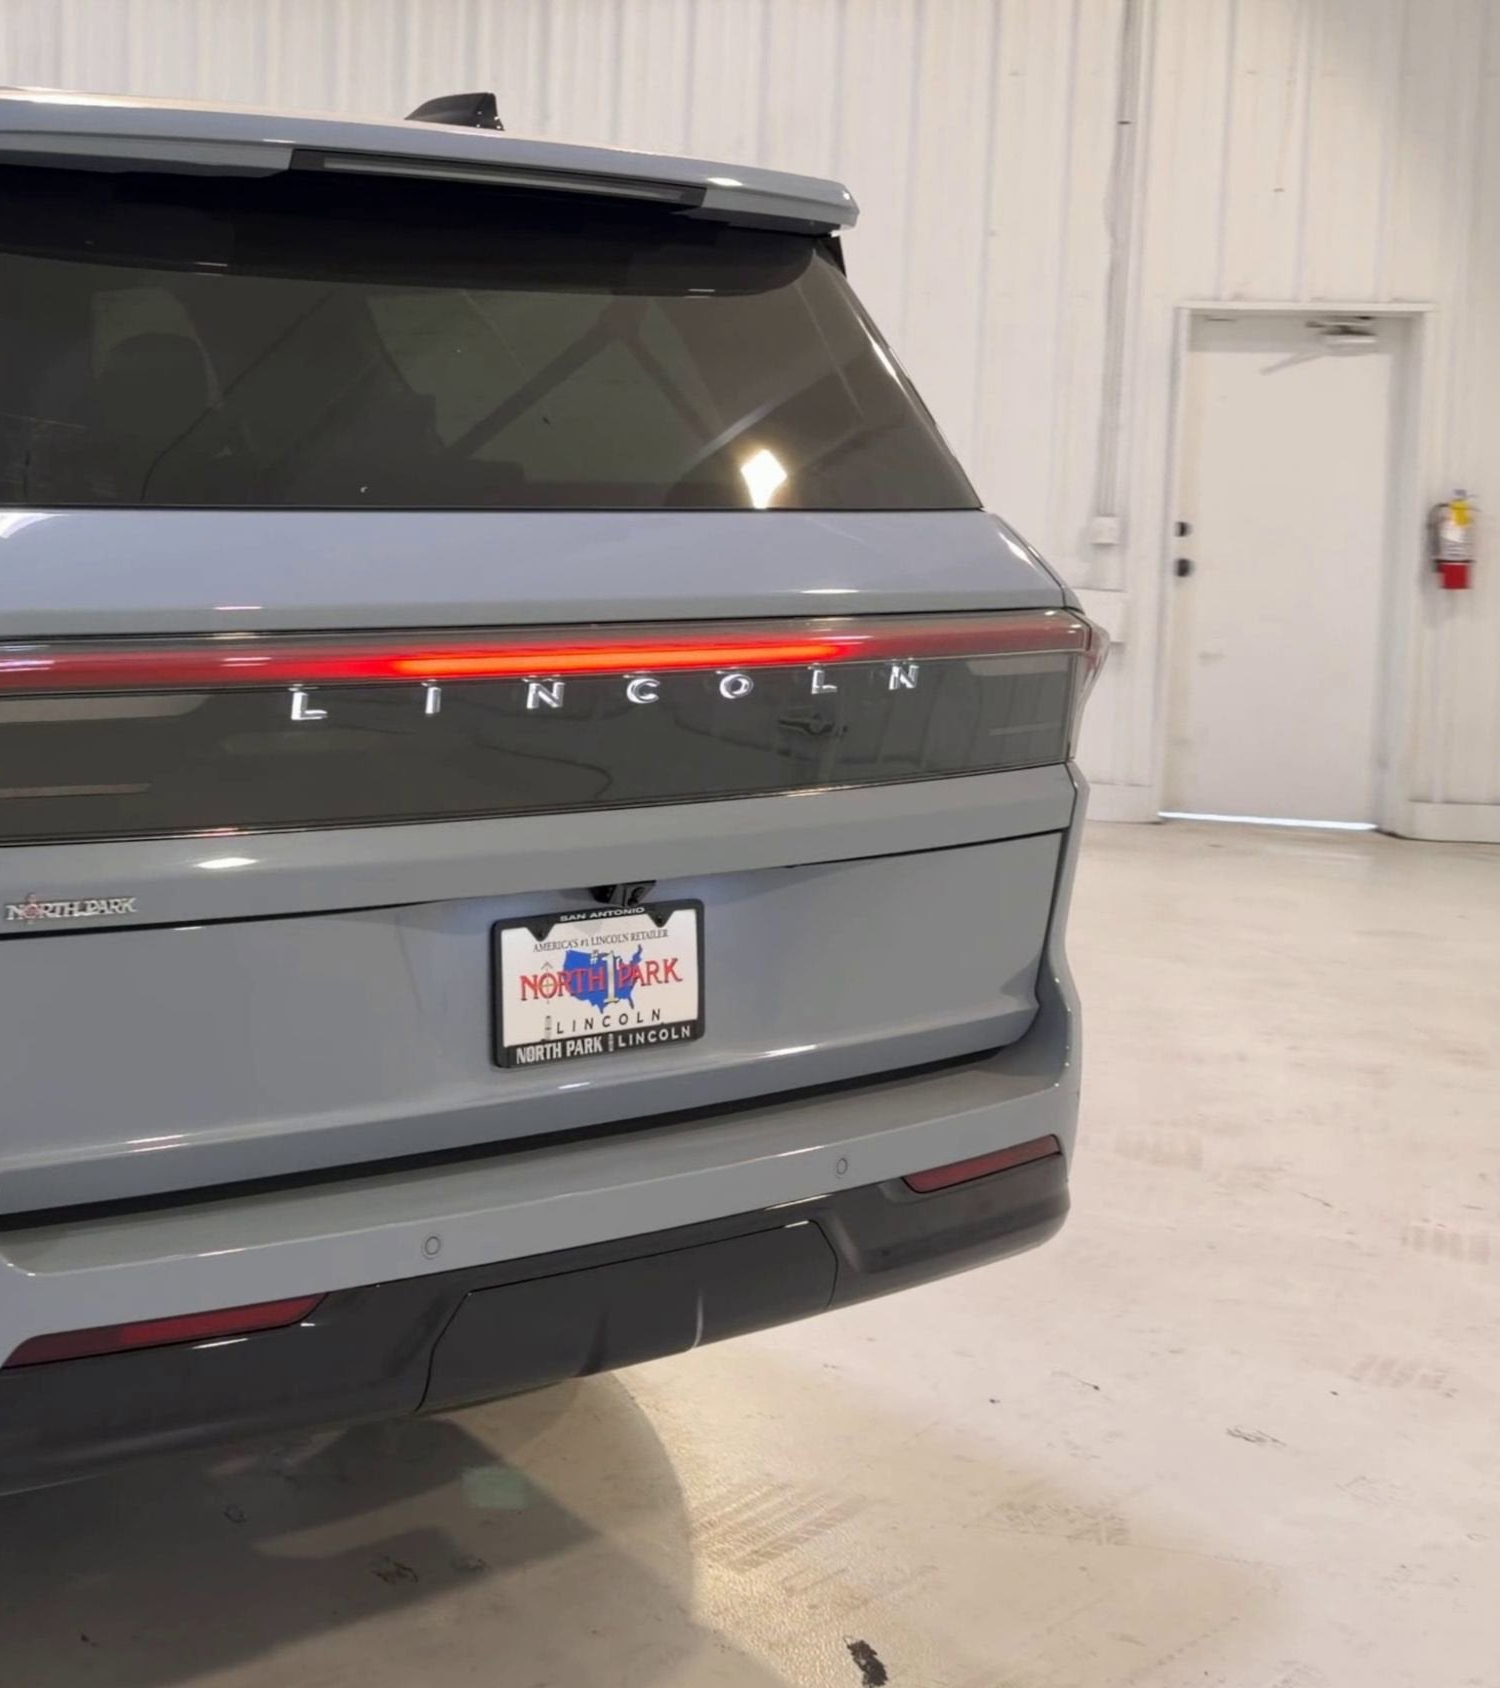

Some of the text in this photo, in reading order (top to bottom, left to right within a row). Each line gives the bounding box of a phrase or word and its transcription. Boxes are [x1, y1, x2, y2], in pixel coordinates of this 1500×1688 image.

[290, 664, 919, 721] LINCOLN
[5, 897, 137, 921] NORTH PARK
[560, 906, 645, 922] SAN ANTONIO
[532, 938, 579, 953] AMERICA'S
[591, 930, 630, 947] LINCOLN
[630, 928, 669, 943] RETAILER
[520, 957, 683, 1001] NORTH PARK
[556, 1008, 662, 1035] LINCOLN
[516, 1025, 692, 1065] NORTH PARK LINCOLN
